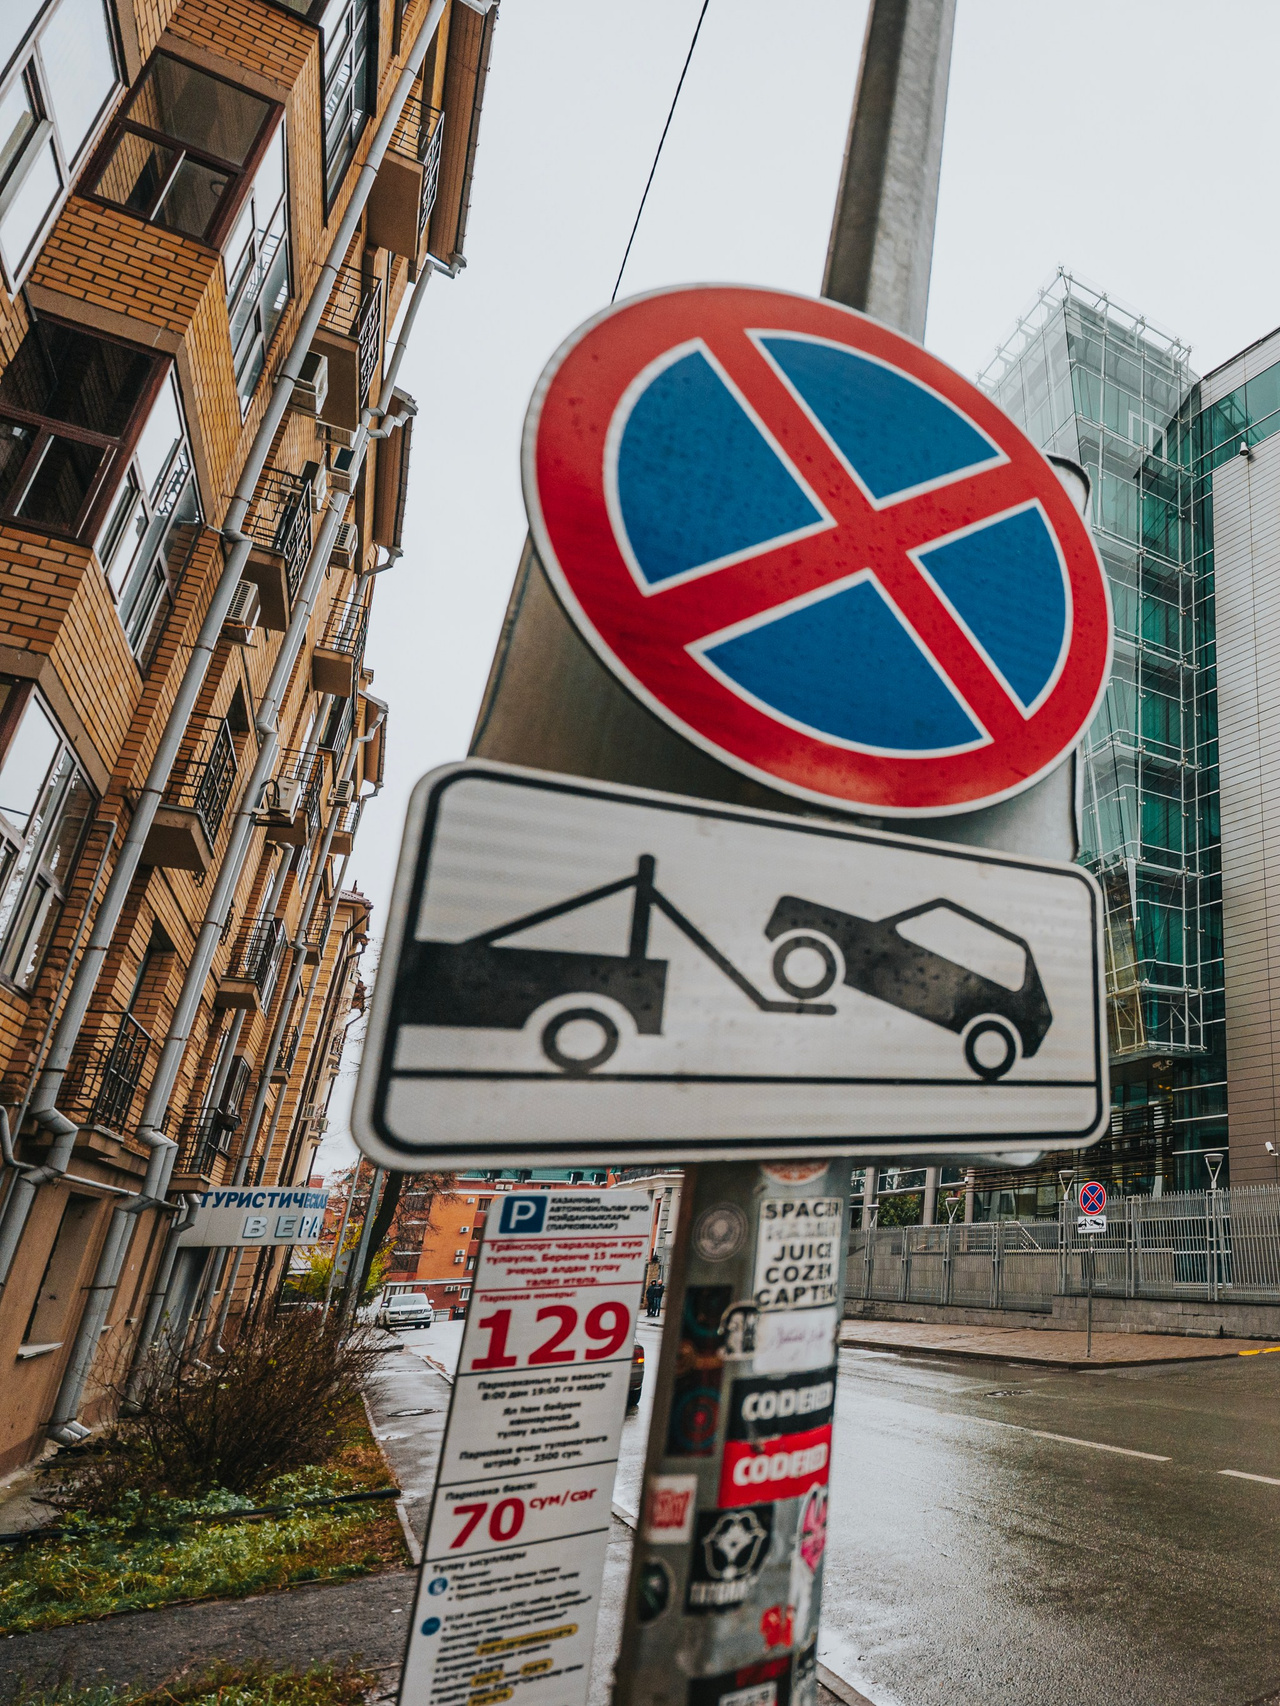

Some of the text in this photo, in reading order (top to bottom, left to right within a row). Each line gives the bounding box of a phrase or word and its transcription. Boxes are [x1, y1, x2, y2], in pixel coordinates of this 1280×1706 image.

[509, 1201, 537, 1230] P
[594, 1252, 606, 1260] 15
[470, 1301, 631, 1370] 129
[449, 1497, 525, 1550] 70
